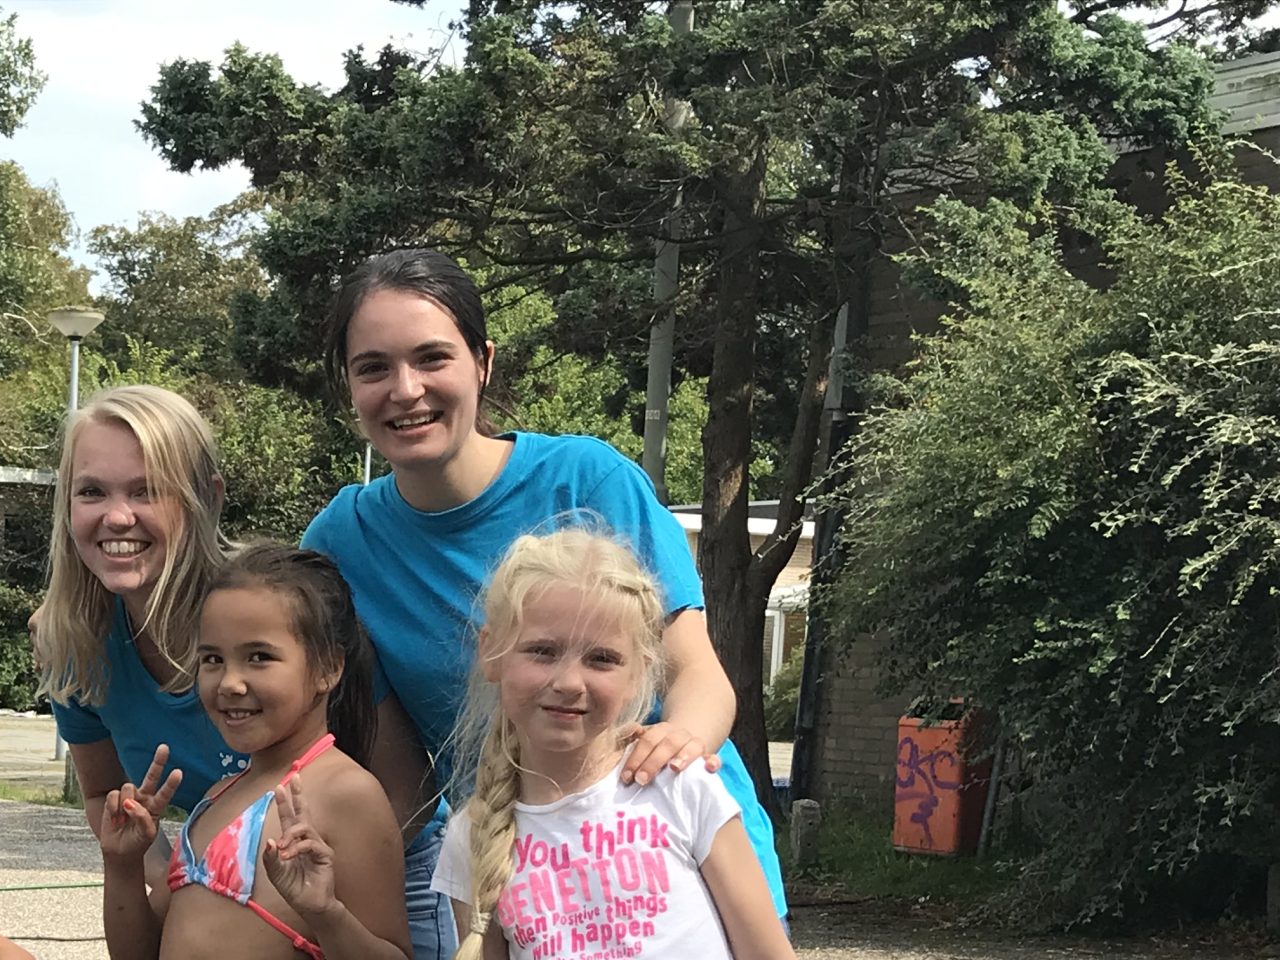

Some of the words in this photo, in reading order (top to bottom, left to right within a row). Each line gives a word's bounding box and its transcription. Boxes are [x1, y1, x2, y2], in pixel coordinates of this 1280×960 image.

[515, 833, 570, 874] you
[580, 811, 670, 859] think
[497, 848, 670, 928] BENETTON
[605, 895, 668, 923] things
[532, 931, 563, 960] will
[571, 920, 655, 952] happen
